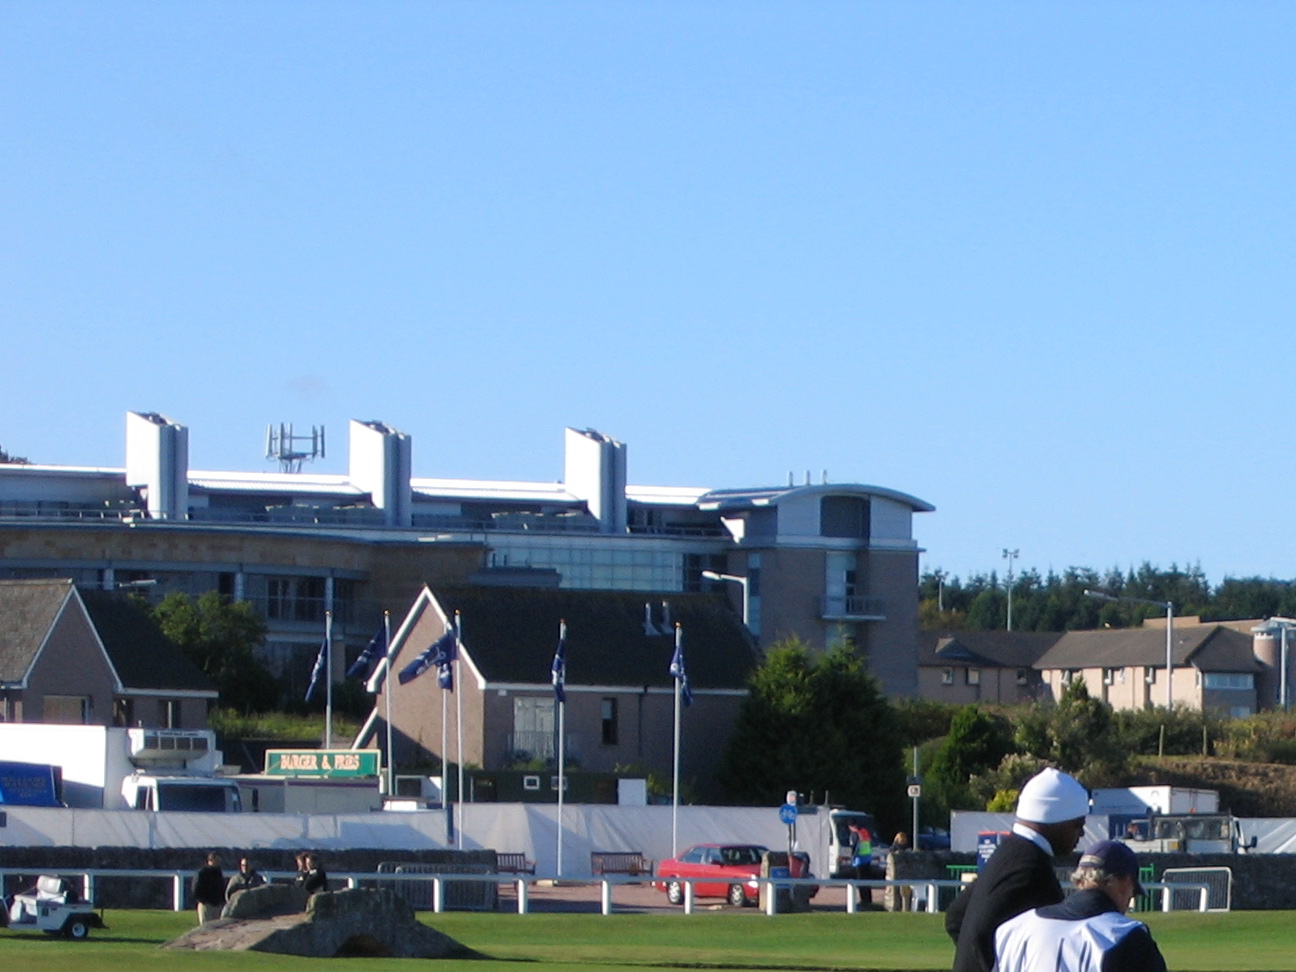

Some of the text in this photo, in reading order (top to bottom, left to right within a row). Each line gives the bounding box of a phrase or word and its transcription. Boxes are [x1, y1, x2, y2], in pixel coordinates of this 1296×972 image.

[281, 754, 360, 770] BURGER & FRIES
